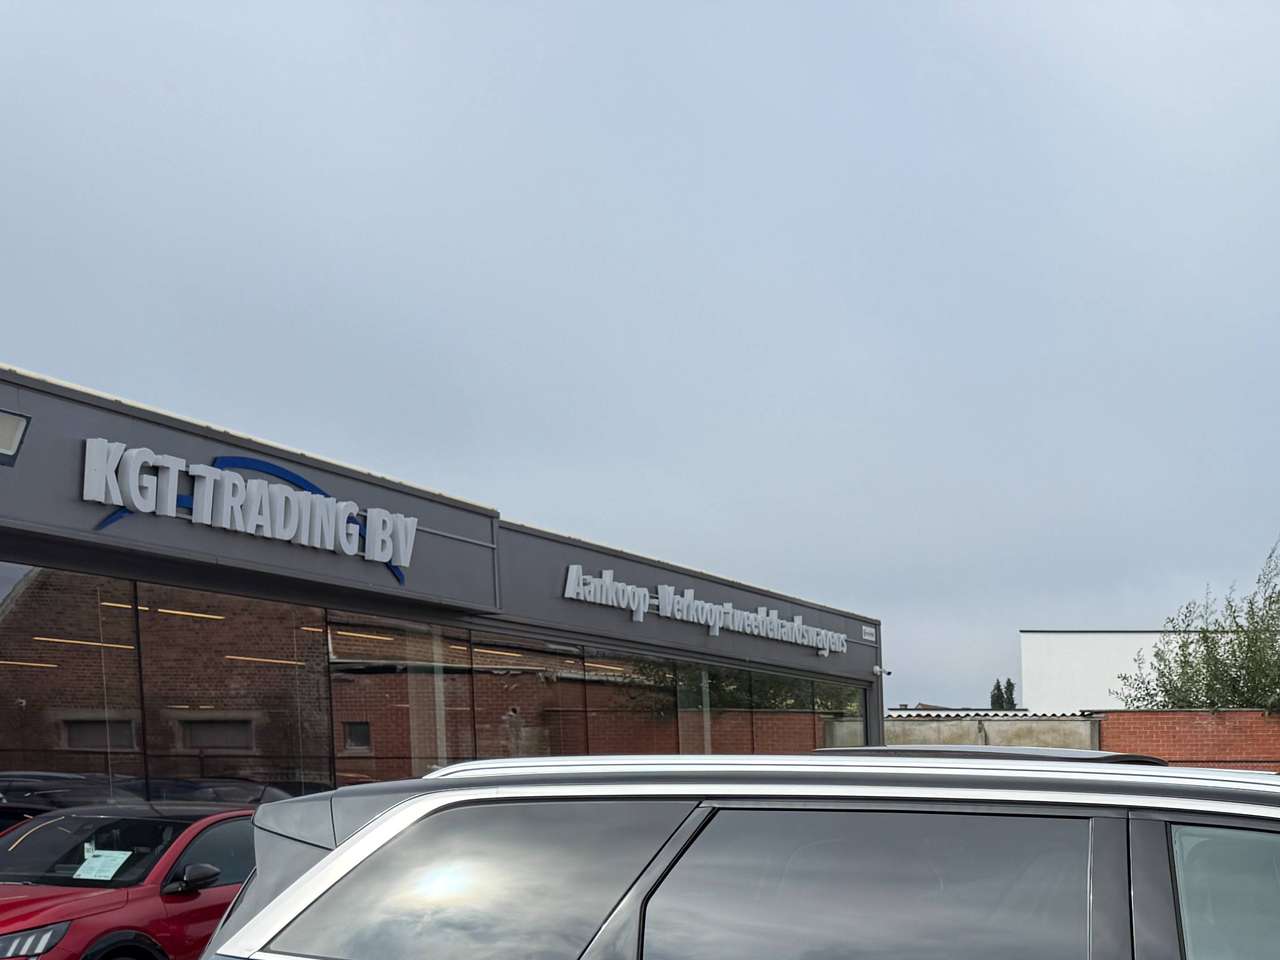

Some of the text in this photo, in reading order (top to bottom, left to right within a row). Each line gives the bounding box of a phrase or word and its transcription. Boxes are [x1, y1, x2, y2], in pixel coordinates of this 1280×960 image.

[83, 437, 418, 568] KGT TRADING BV
[564, 564, 650, 623] Aankoop
[658, 584, 723, 637] Verkoop
